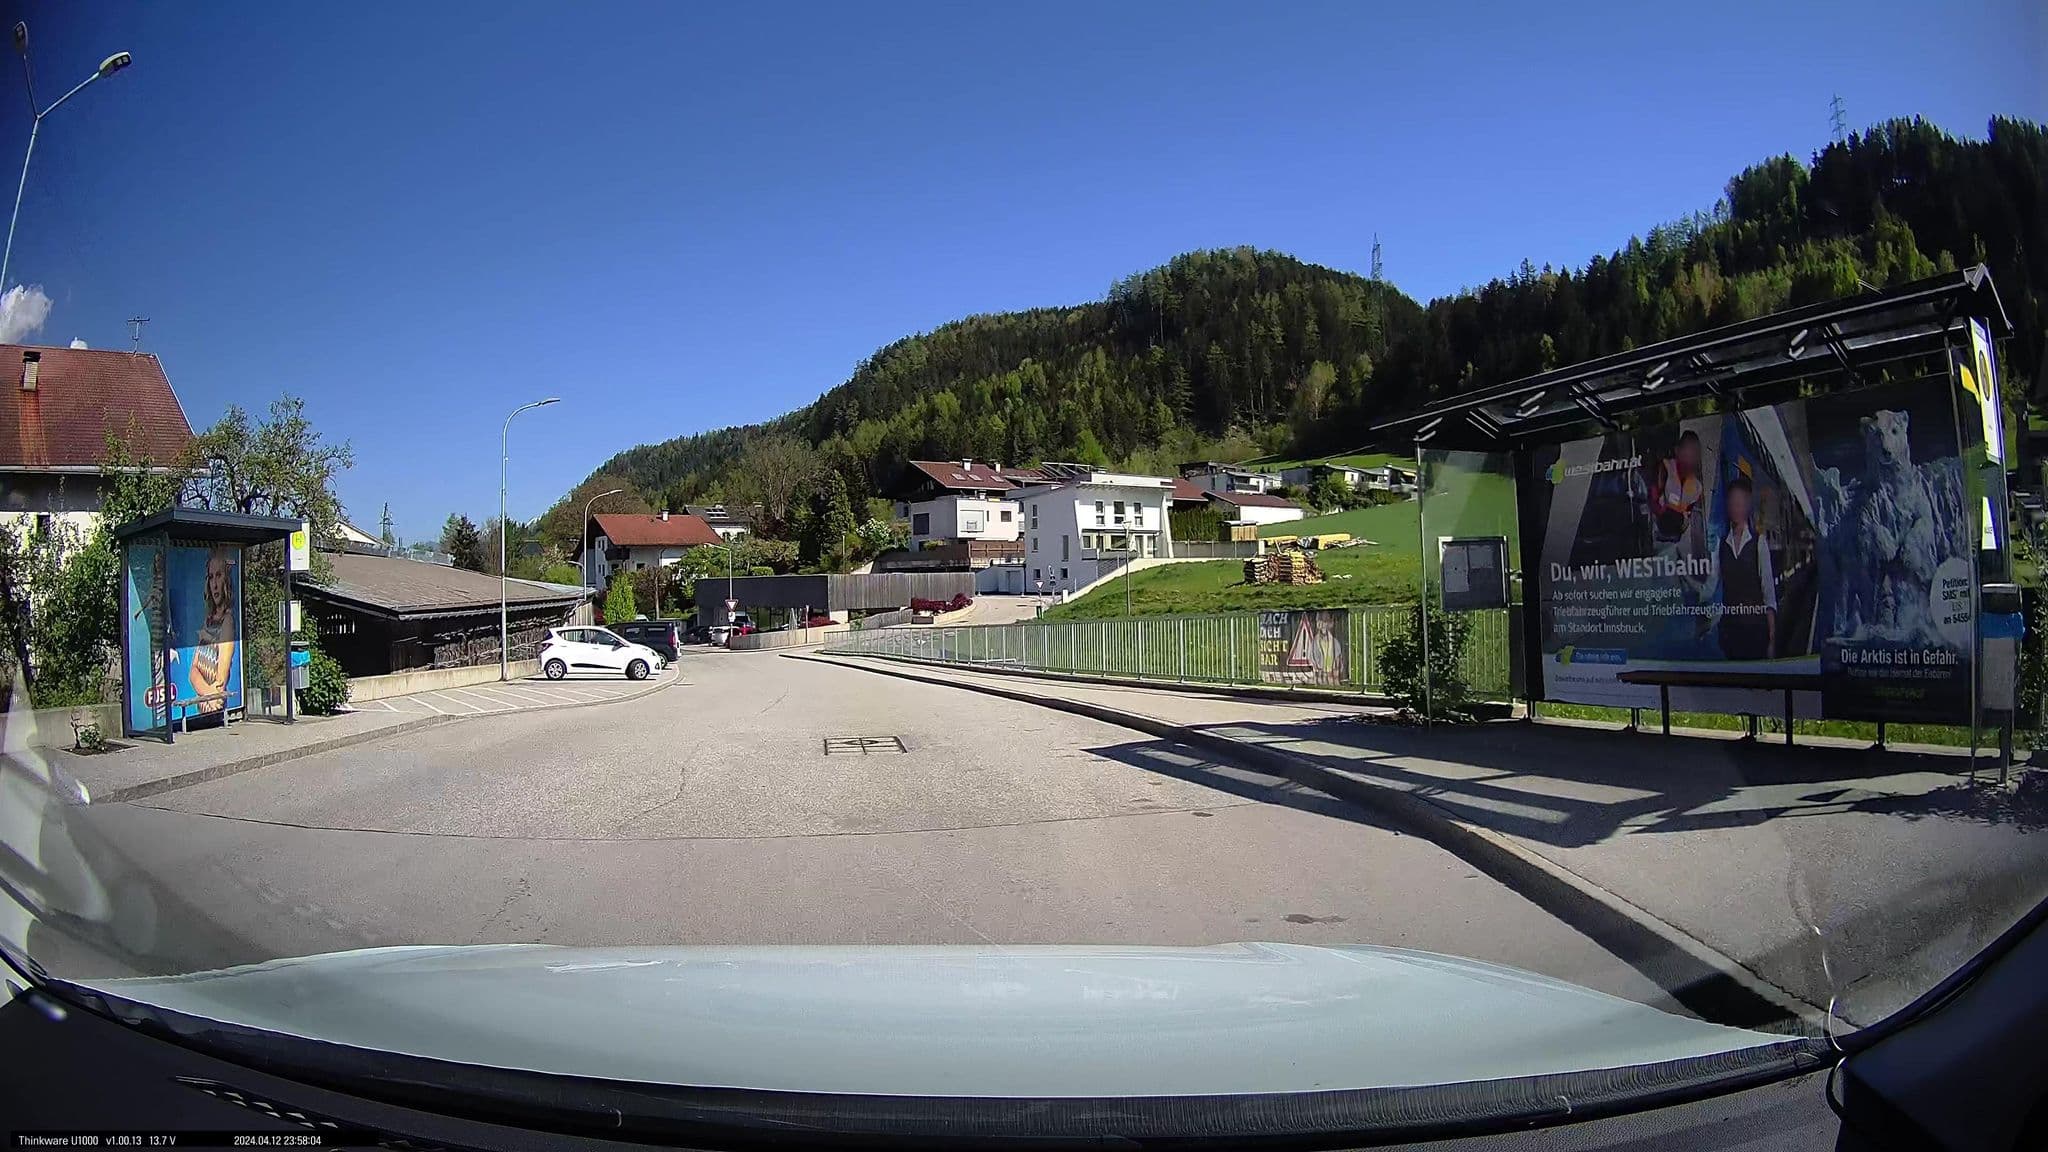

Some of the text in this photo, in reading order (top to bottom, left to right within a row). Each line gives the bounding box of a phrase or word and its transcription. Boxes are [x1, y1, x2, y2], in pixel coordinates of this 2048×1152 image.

[1550, 553, 1712, 583] Du, wir, WESTbahn
[1552, 587, 1681, 601] Ab sofort suchen wir engagierte
[1632, 605, 1649, 616] und
[1553, 624, 1567, 633] am
[1567, 622, 1602, 633] Standort
[1841, 648, 1959, 665] Die Arktis ist in Gefahr.
